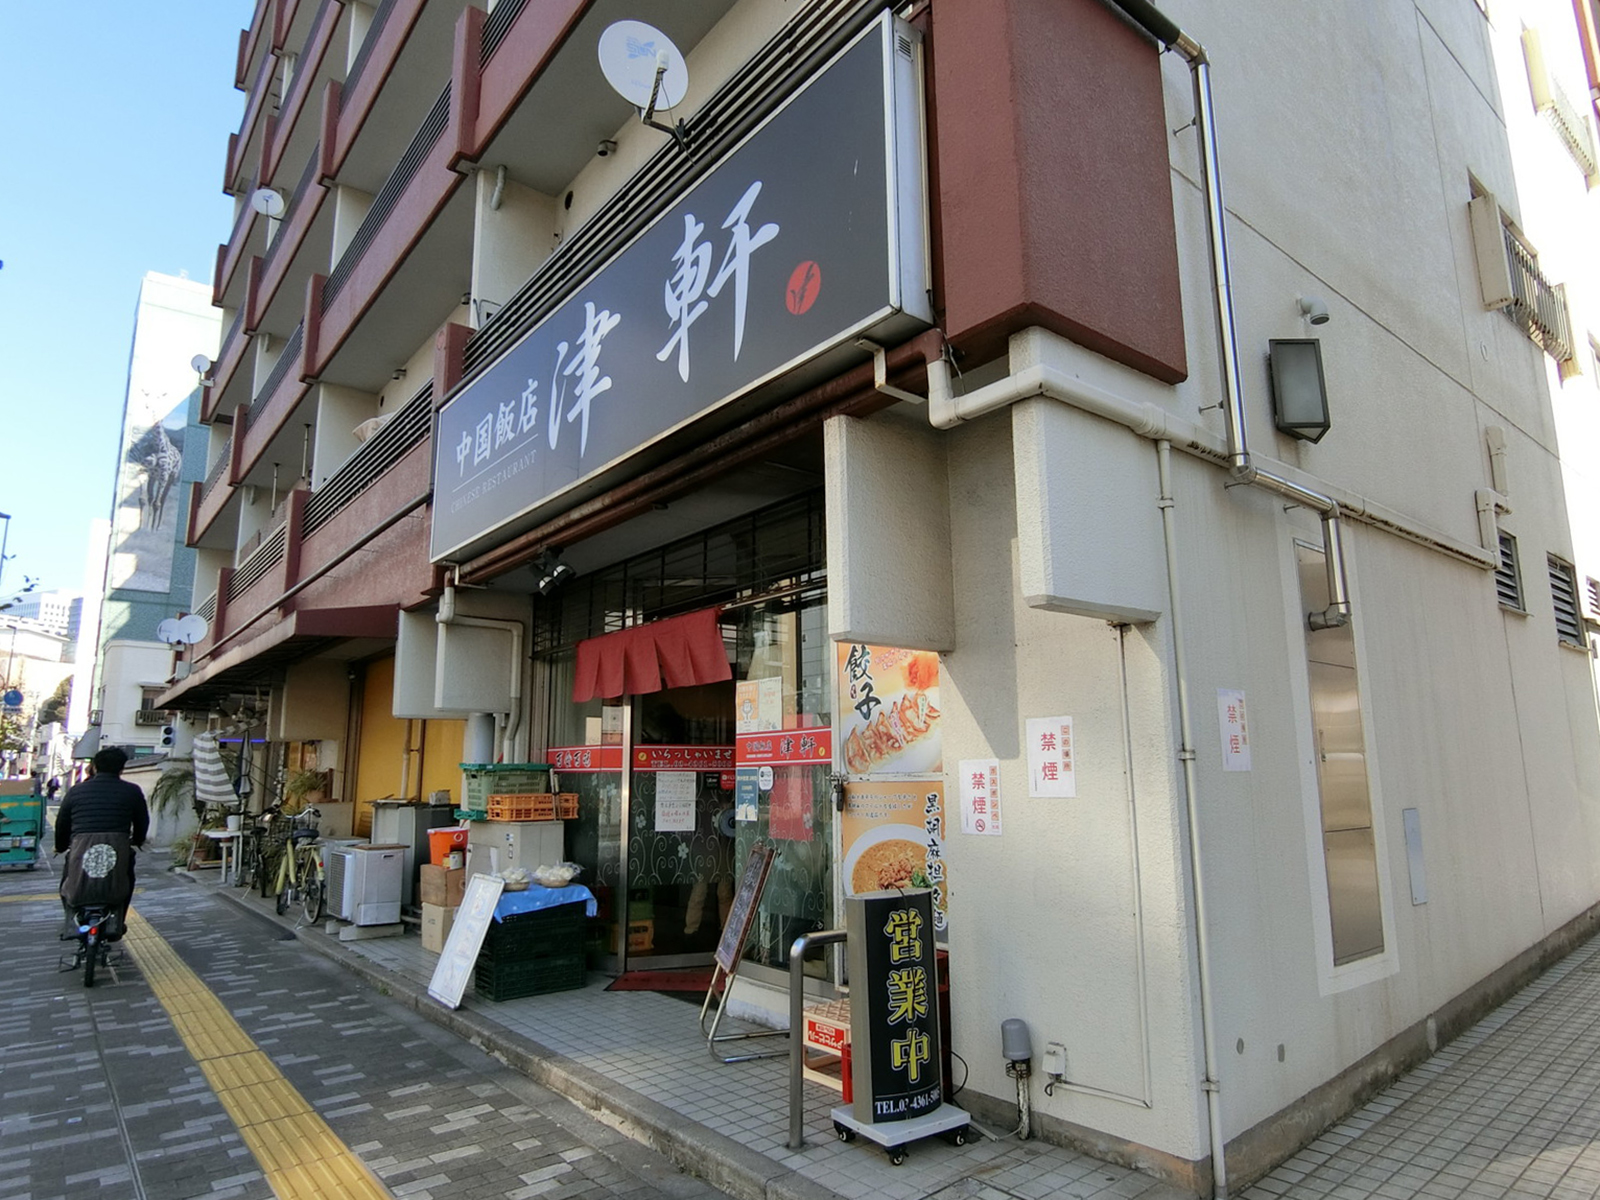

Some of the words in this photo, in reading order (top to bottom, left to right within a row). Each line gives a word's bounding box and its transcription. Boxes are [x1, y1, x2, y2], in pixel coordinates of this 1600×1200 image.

[456, 378, 538, 478] 中国飯店
[548, 180, 780, 459] 津軒
[844, 644, 881, 721] 餃子
[651, 749, 733, 760] いらっしゃいませ
[1041, 732, 1058, 780] 禁煙
[971, 772, 987, 814] 禁煙
[884, 908, 930, 1083] 営業中
